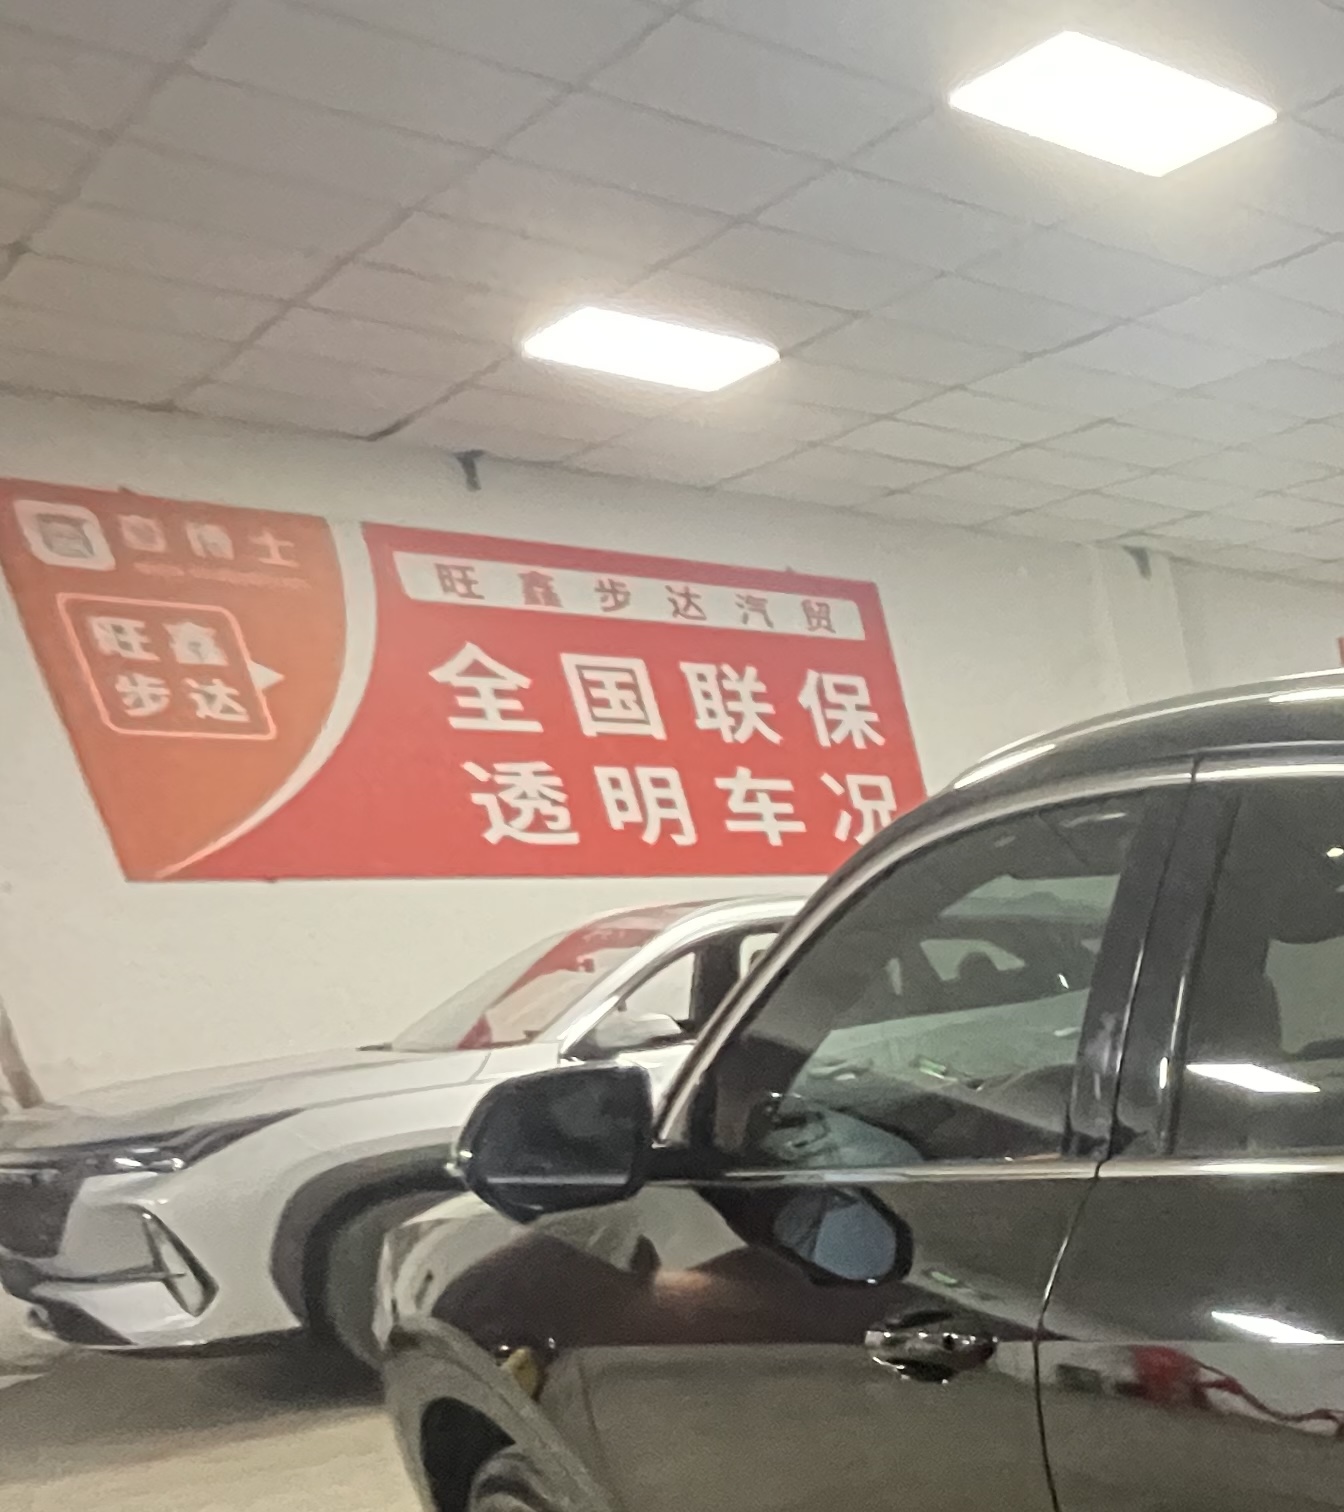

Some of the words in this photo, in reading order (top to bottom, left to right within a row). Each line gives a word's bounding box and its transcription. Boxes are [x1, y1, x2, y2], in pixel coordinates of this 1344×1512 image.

[435, 562, 836, 634] 旺鑫步达汽贸
[114, 671, 250, 723] 步达
[428, 641, 887, 749] 全国联保
[462, 761, 898, 846] 透明车况
